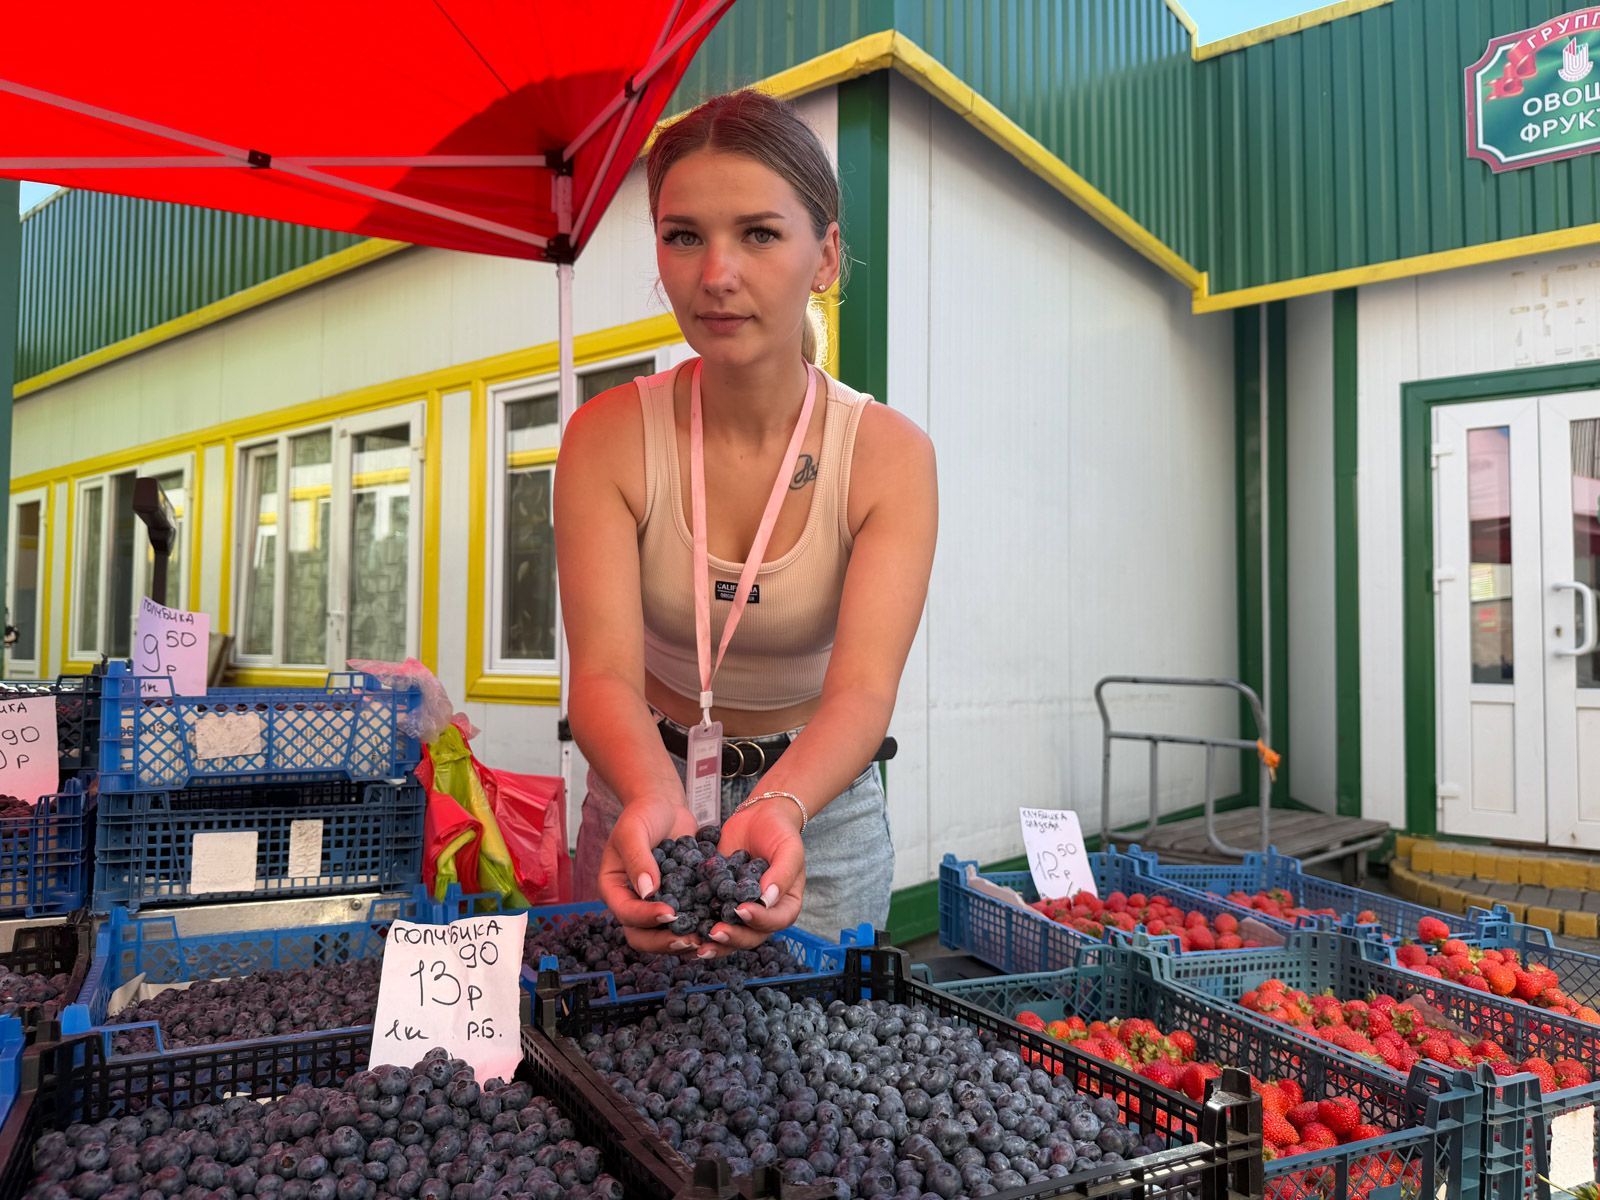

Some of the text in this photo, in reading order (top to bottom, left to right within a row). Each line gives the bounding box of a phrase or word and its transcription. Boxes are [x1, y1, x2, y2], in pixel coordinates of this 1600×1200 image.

[143, 599, 194, 624] ГОЛУБИКА
[143, 634, 160, 673] 9
[166, 630, 197, 648] 50
[1, 726, 40, 746] 90
[1035, 851, 1060, 880] 12
[1057, 843, 1077, 857] 50
[394, 920, 503, 946] ГОЛУБИКА
[410, 959, 462, 1008] 13
[459, 941, 499, 968] 90
